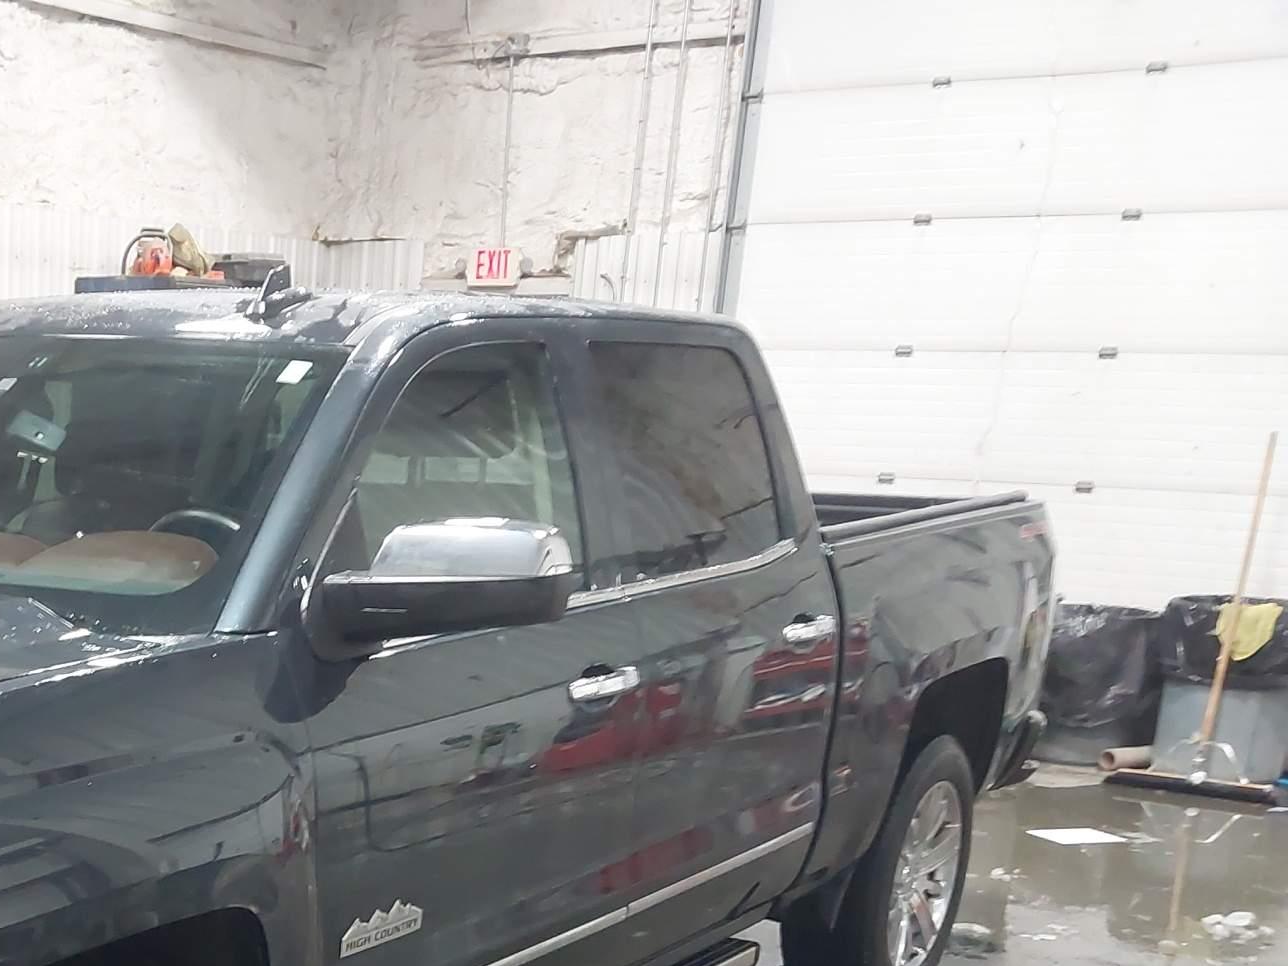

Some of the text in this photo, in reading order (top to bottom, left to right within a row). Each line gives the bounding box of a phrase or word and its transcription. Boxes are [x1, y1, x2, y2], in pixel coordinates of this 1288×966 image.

[475, 250, 512, 280] EXIT
[345, 918, 418, 951] HIGH COUNTRY
